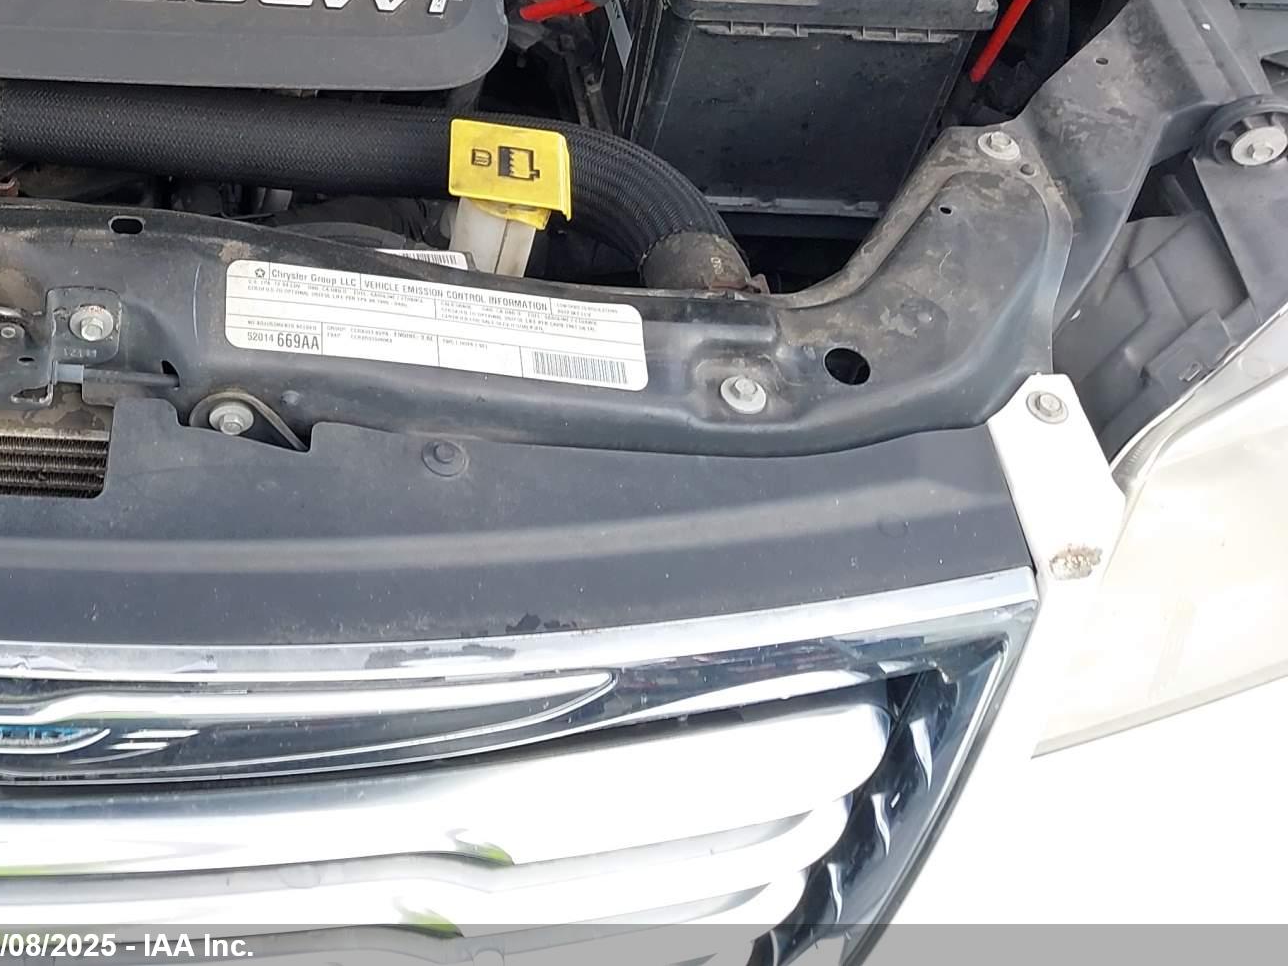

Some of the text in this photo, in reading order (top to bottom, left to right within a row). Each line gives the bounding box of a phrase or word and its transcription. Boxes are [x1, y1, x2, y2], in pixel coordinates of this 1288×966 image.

[271, 268, 357, 287] Chrysler Group LLC
[364, 279, 399, 292] VEHICLE
[402, 284, 444, 299] EMISSION
[446, 290, 486, 304] CONTROL
[488, 295, 548, 311] INFORMATION
[247, 331, 274, 342] 52014
[277, 332, 320, 351] 669AA
